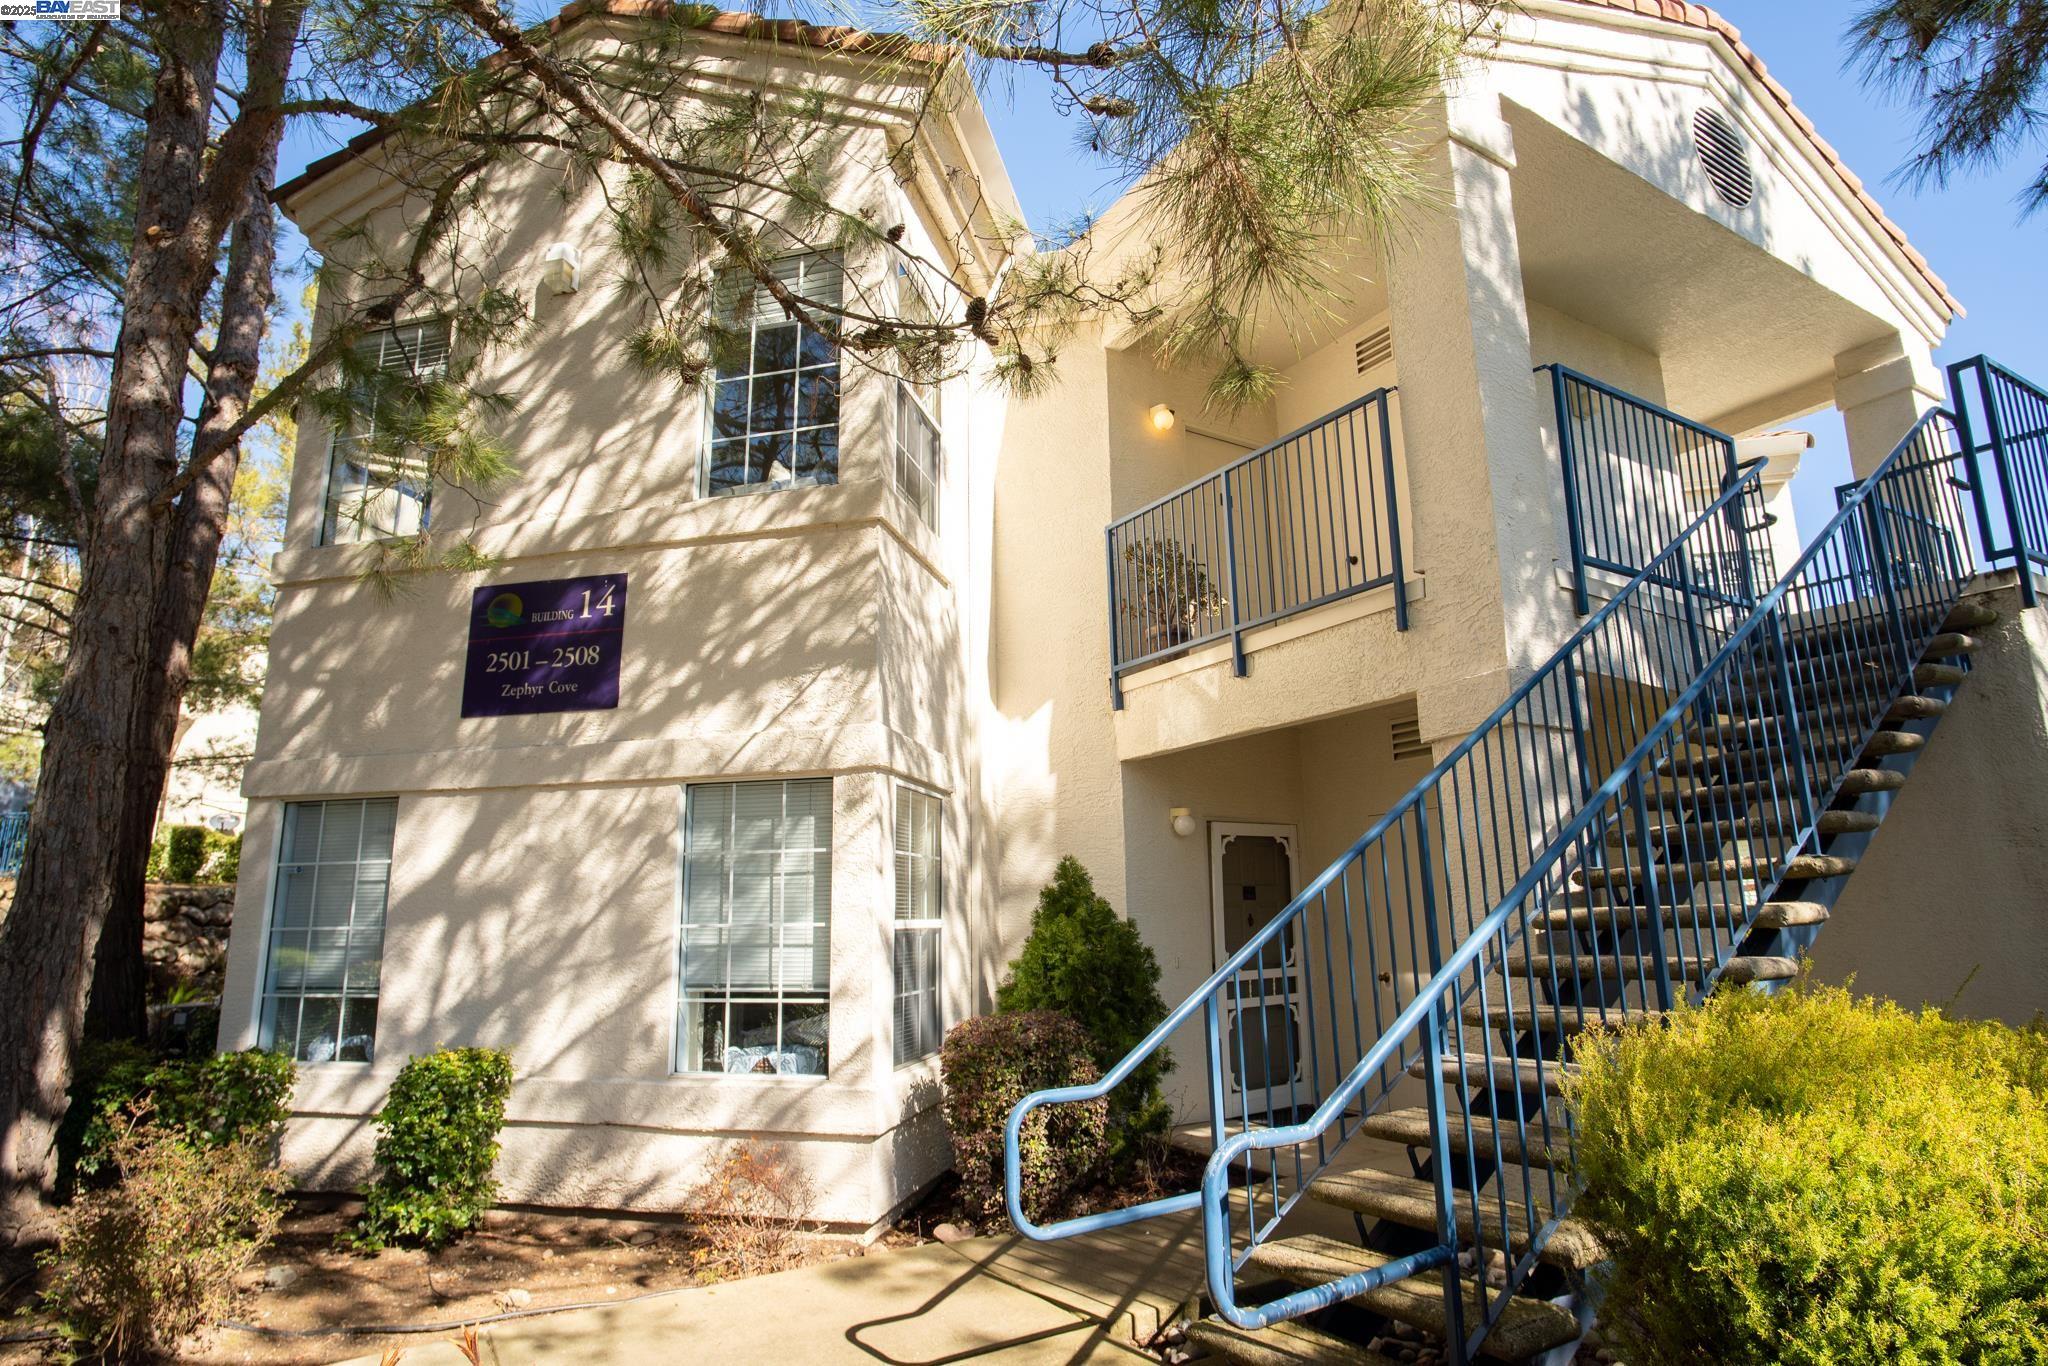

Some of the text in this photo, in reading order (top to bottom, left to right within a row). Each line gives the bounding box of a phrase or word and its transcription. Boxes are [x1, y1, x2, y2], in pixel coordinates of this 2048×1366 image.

[532, 584, 616, 623] BUILDING 14
[486, 650, 530, 673] 2501
[551, 645, 600, 669] 2508
[501, 681, 578, 699] Zephyr Cove
